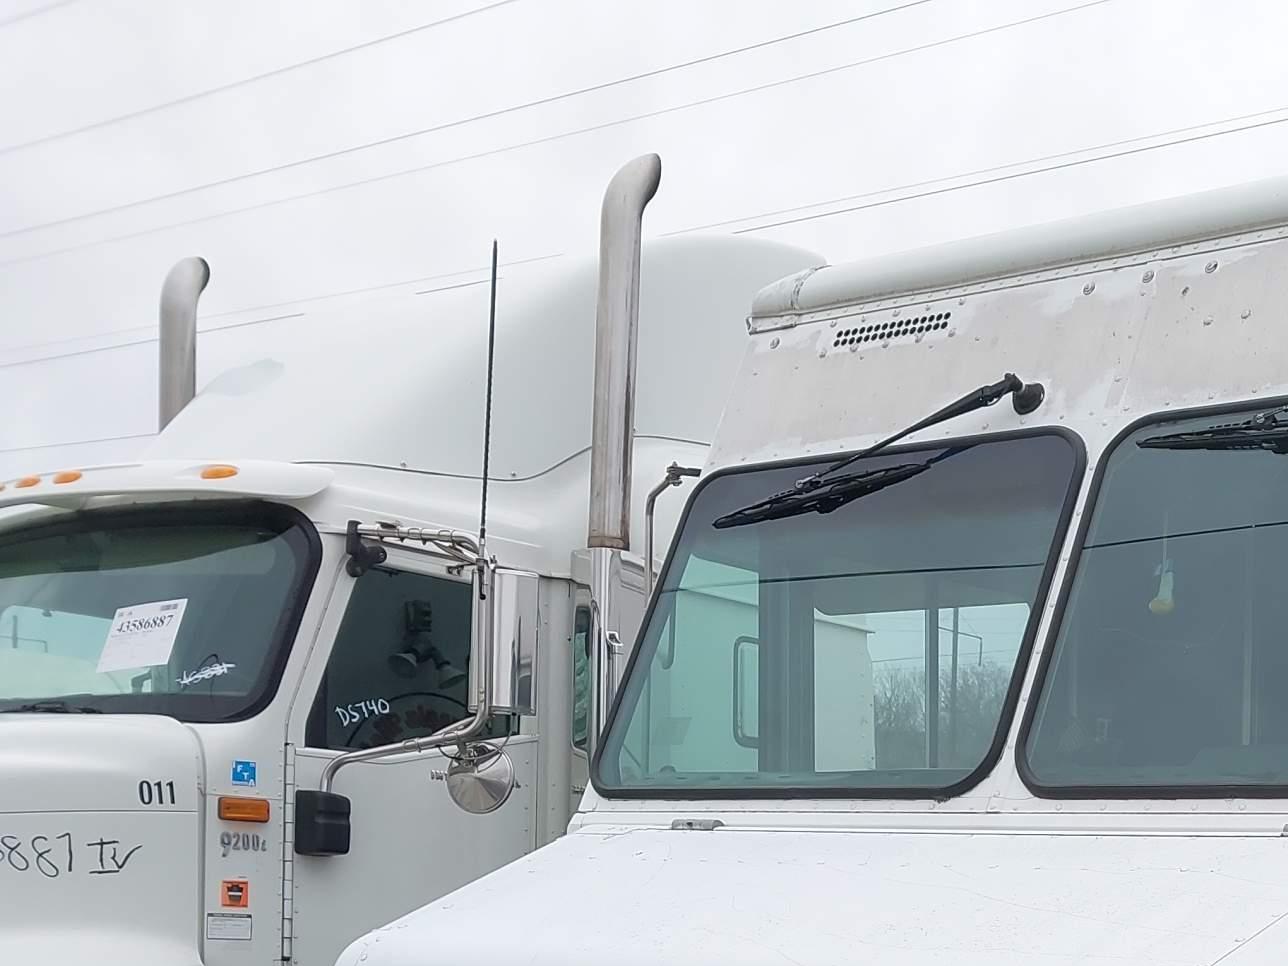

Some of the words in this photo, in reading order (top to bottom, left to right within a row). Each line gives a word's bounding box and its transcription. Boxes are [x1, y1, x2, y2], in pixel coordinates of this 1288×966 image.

[116, 614, 174, 633] 43586887
[138, 780, 176, 806] 011
[0, 832, 73, 878] 887
